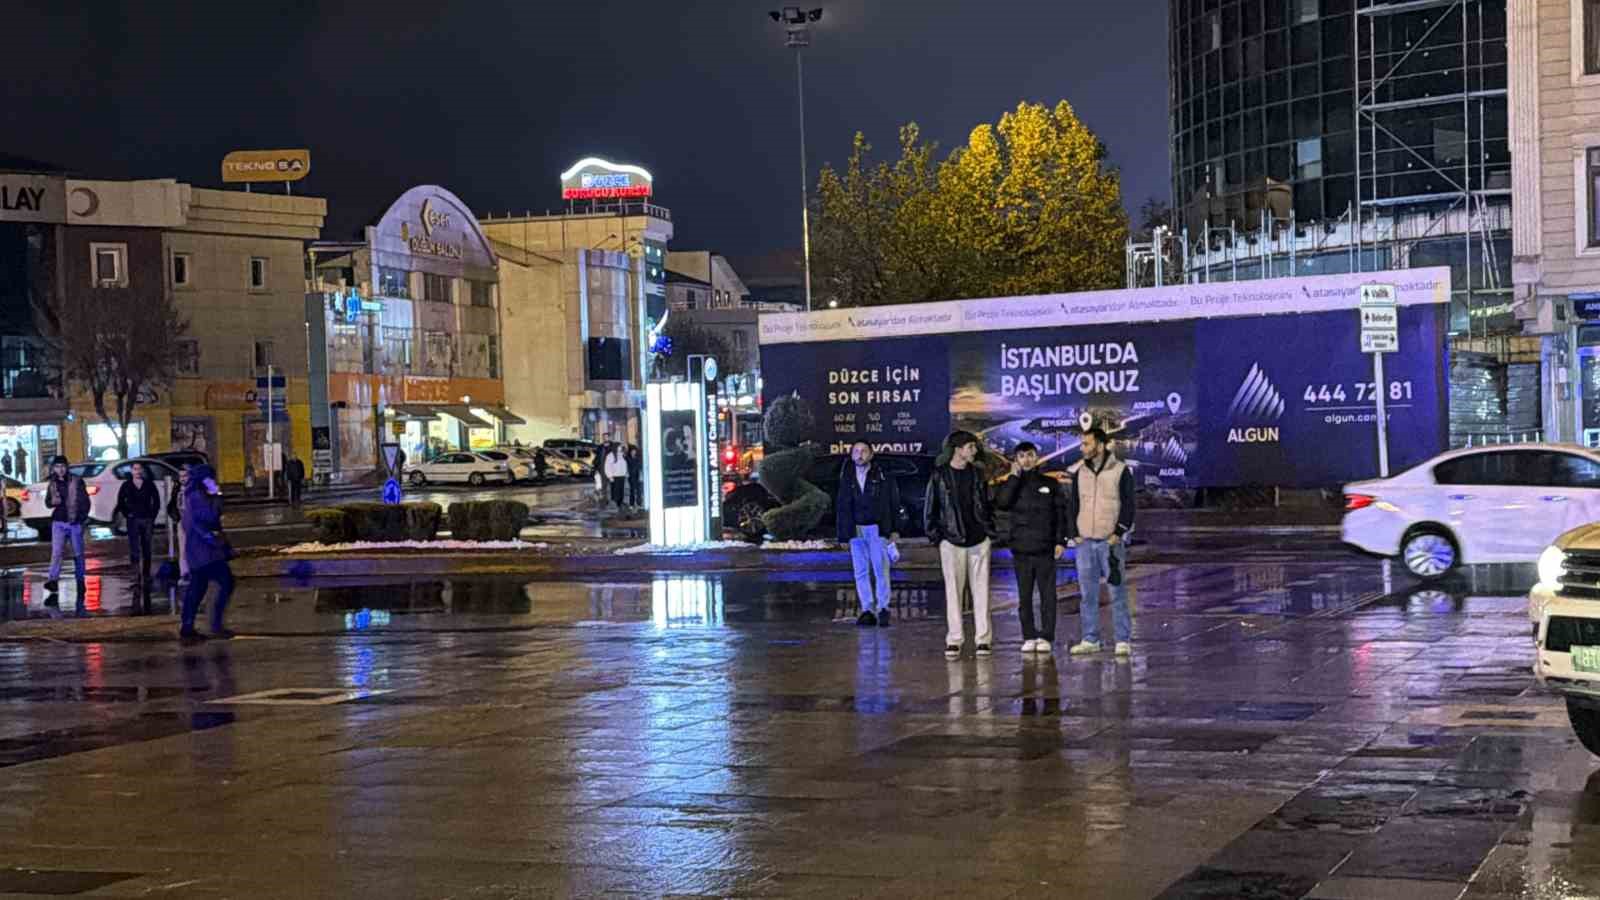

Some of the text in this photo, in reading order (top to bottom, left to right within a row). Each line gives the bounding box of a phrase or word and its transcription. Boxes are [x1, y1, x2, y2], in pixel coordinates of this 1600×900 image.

[1001, 342, 1138, 369] İSTANBUL'DA
[829, 365, 920, 385] DÜZCE İÇİN
[1001, 370, 1140, 401] BAŞLIYORUZ
[1304, 383, 1347, 402] 444
[1390, 381, 1413, 400] 81
[828, 389, 921, 405] SON FIRSAT
[1227, 427, 1280, 443] ALGUN
